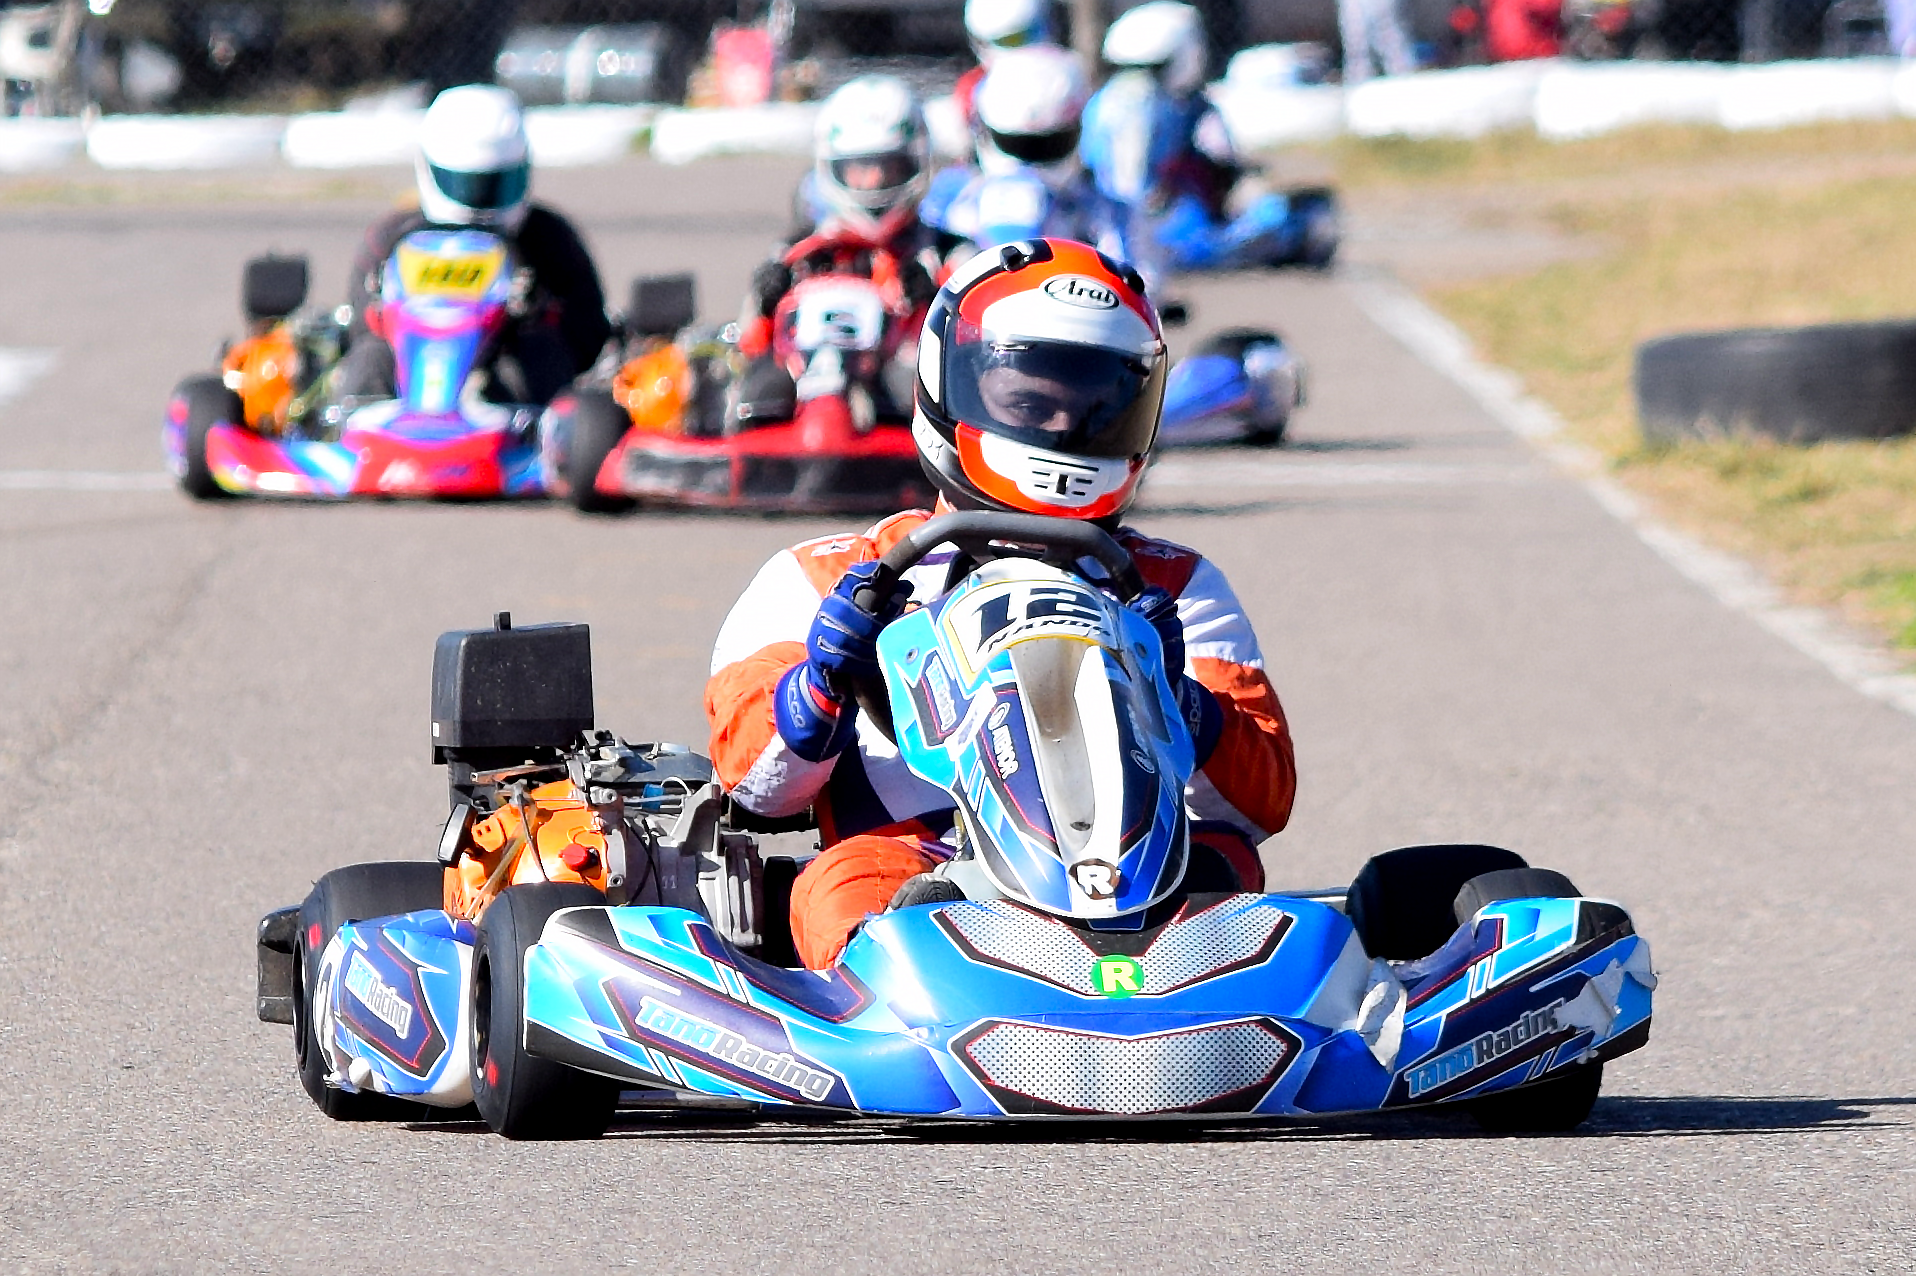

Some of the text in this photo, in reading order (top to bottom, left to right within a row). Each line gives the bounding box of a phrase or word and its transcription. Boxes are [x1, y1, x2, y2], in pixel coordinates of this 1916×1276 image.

[1048, 278, 1112, 304] Arai
[971, 587, 1102, 655] 12
[1076, 864, 1116, 896] R
[1101, 961, 1140, 992] R
